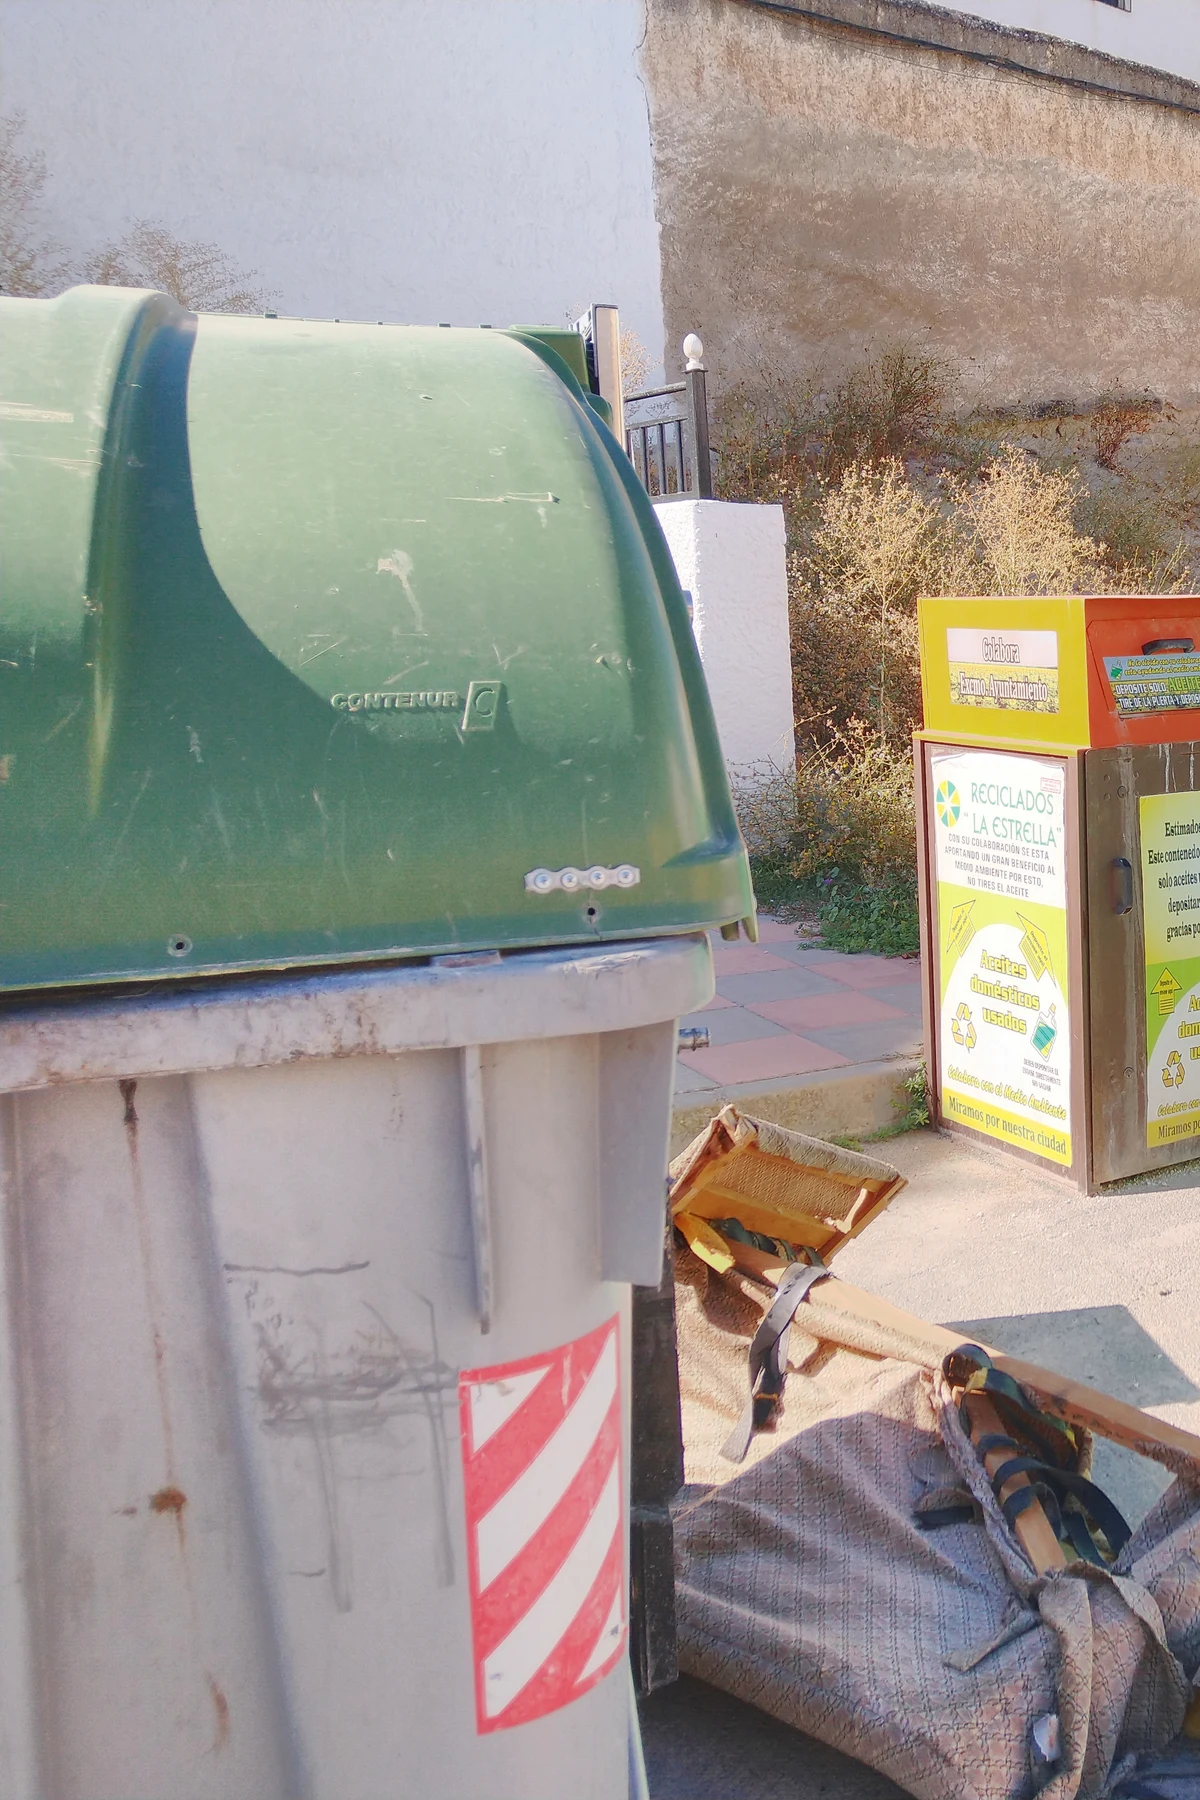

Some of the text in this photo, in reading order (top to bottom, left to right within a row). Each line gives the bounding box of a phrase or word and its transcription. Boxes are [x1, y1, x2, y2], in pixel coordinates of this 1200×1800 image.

[982, 637, 1020, 663] Colabora
[959, 672, 1047, 703] Excmo. Ayuntamiento
[1115, 683, 1147, 695] DEPOSITE
[1149, 682, 1166, 692] SOLO
[330, 691, 459, 711] CONTENUR
[1119, 698, 1134, 709] TIRE
[1134, 698, 1142, 707] DE
[1143, 697, 1152, 707] LA
[1152, 696, 1174, 706] PUERTA
[971, 782, 1054, 815] RECICLADOS
[949, 833, 1049, 860] CON SU COLABORACIÓN SE ESTA
[1148, 849, 1164, 864] Este
[945, 846, 1056, 876] APORTANDO UN GRAN BENEFICIO AL
[955, 860, 973, 872] MEDIO
[975, 864, 1008, 880] AMBIENTE
[1009, 871, 1022, 883] POR
[967, 876, 1029, 898] NO TIRES EL ACEITE
[1158, 872, 1173, 889] solo
[1173, 870, 1198, 887] aceites
[1168, 895, 1200, 916] depositar
[1166, 921, 1192, 943] gracias
[980, 949, 1027, 980] Aceites
[970, 974, 1040, 1011] domésticos
[982, 1007, 1027, 1035] usados
[948, 1064, 1067, 1121] Colabora con el Medio Ambiente
[1157, 1101, 1188, 1117] Colabora
[1188, 1098, 1200, 1109] con
[948, 1095, 1066, 1155] Miramos por nuestra ciudad
[1158, 1120, 1191, 1139] Miramos
